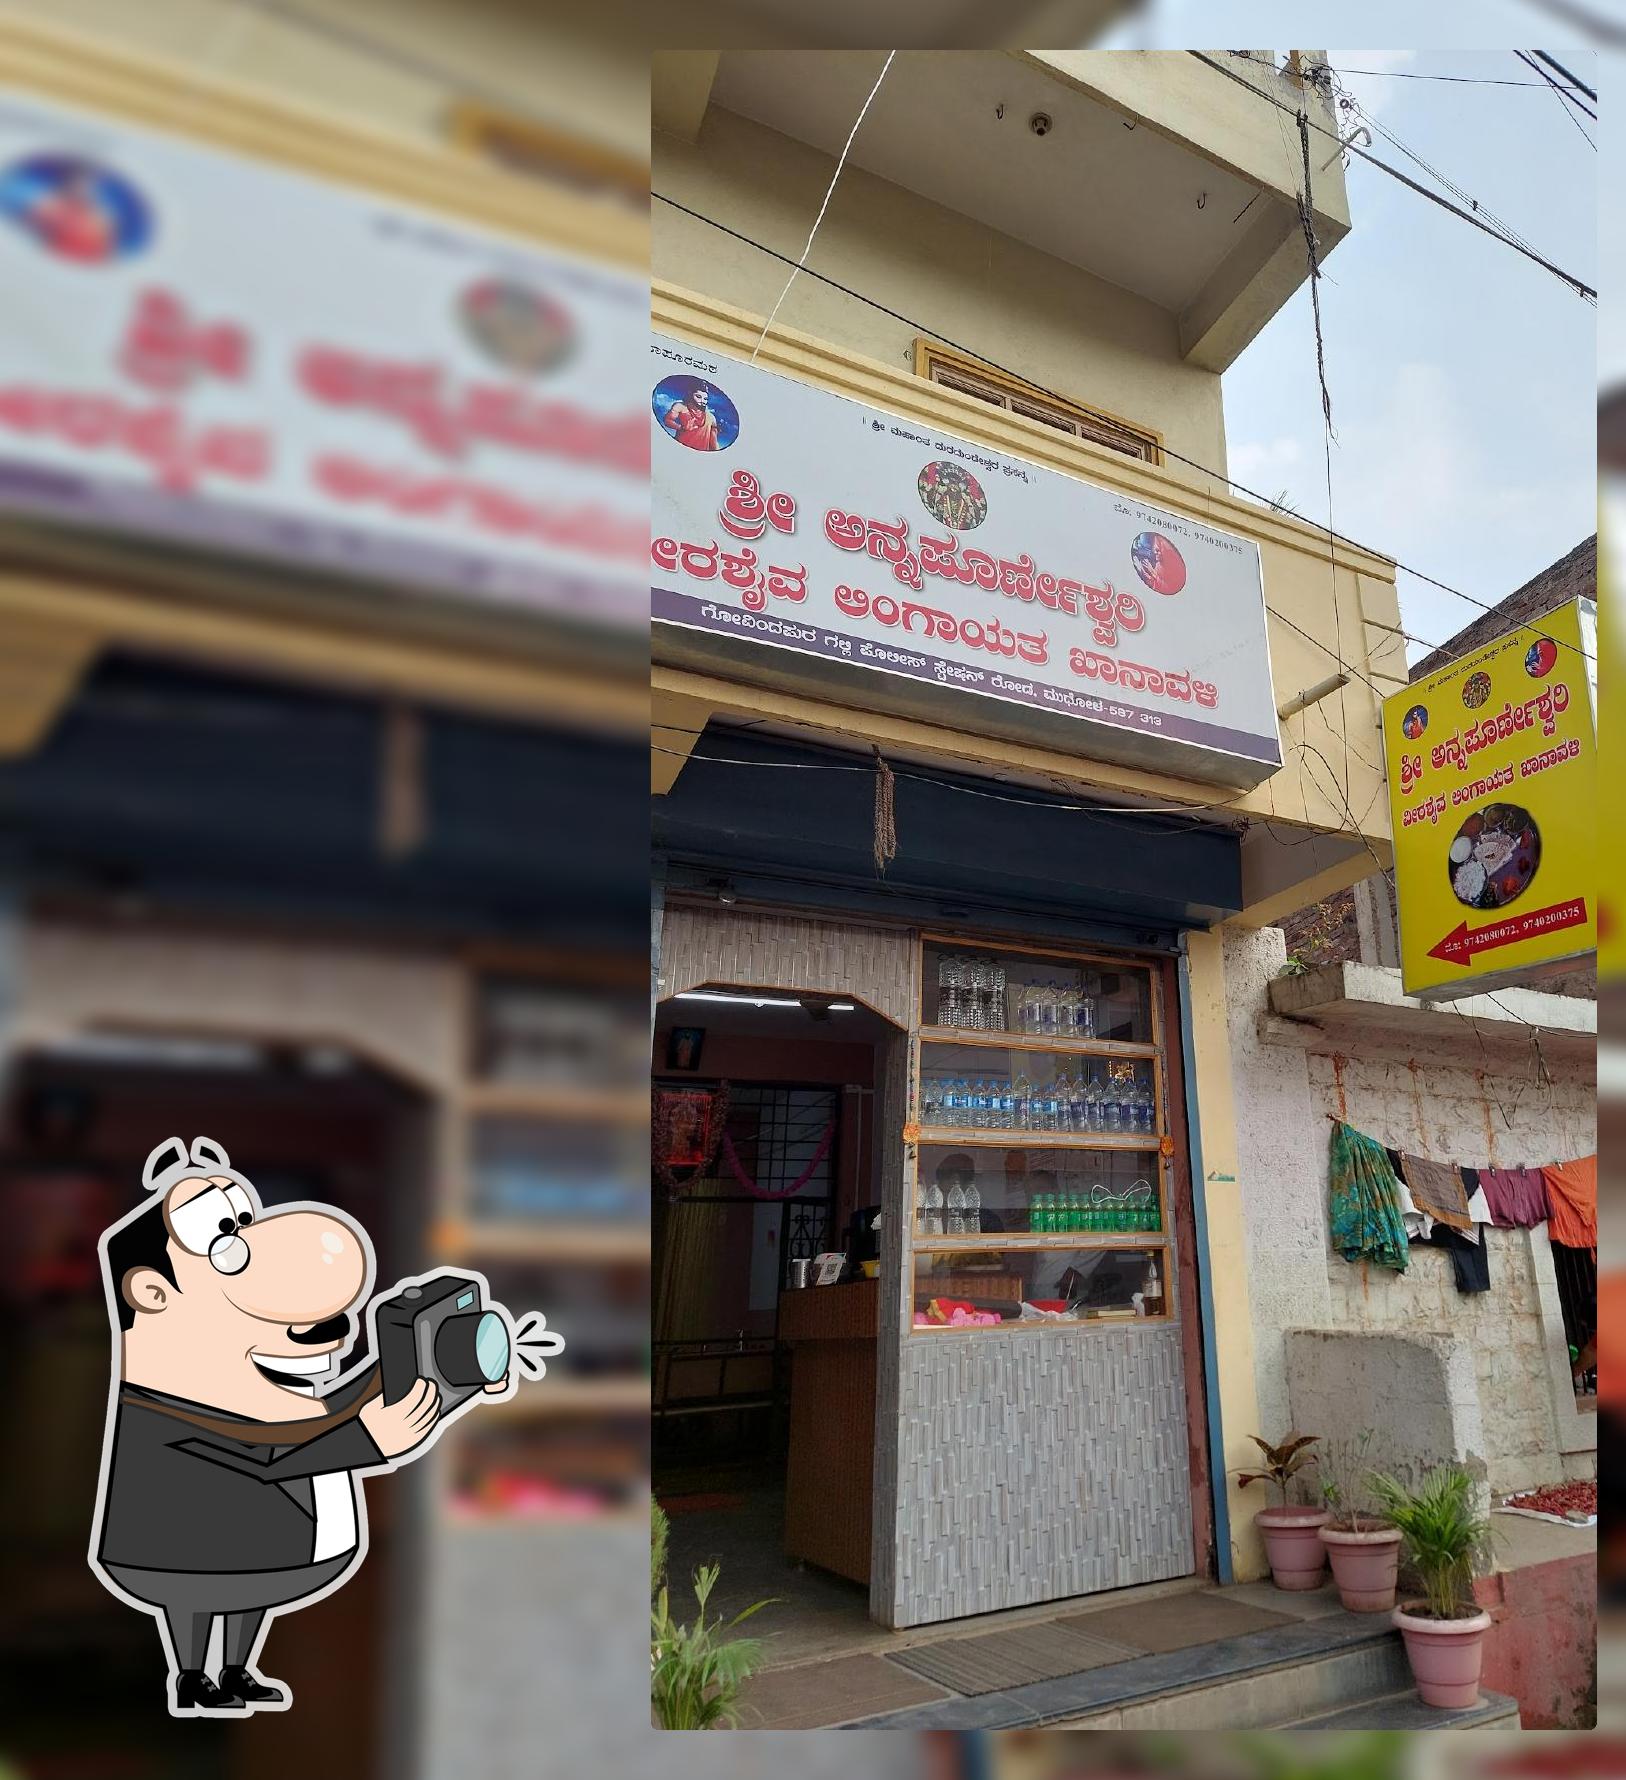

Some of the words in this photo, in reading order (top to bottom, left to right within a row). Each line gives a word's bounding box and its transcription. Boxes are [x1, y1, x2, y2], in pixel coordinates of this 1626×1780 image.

[718, 469, 796, 540] ಶ್ರೀ
[824, 508, 1147, 647] ಅನ್ನಪೂರ್ಣೇಶ್ವರಿ
[701, 603, 817, 642] ಗೋವಿಂದಪುರ
[824, 634, 852, 657] ಗಲ್ಲಿ
[1139, 713, 1163, 727] 313
[833, 583, 1050, 666] ಲಿಂಗಾಯತ
[1068, 645, 1220, 710] ಖಾನಾವಳಿ
[1400, 754, 1423, 795] ಶ್ರೀ
[1402, 792, 1446, 827] ವೀರಶೈವ
[1452, 762, 1515, 806] ಲಿಂಗಾಯತ
[1519, 738, 1580, 778] ಖಾನಾವಳಿ
[1523, 905, 1580, 930] 9740200375
